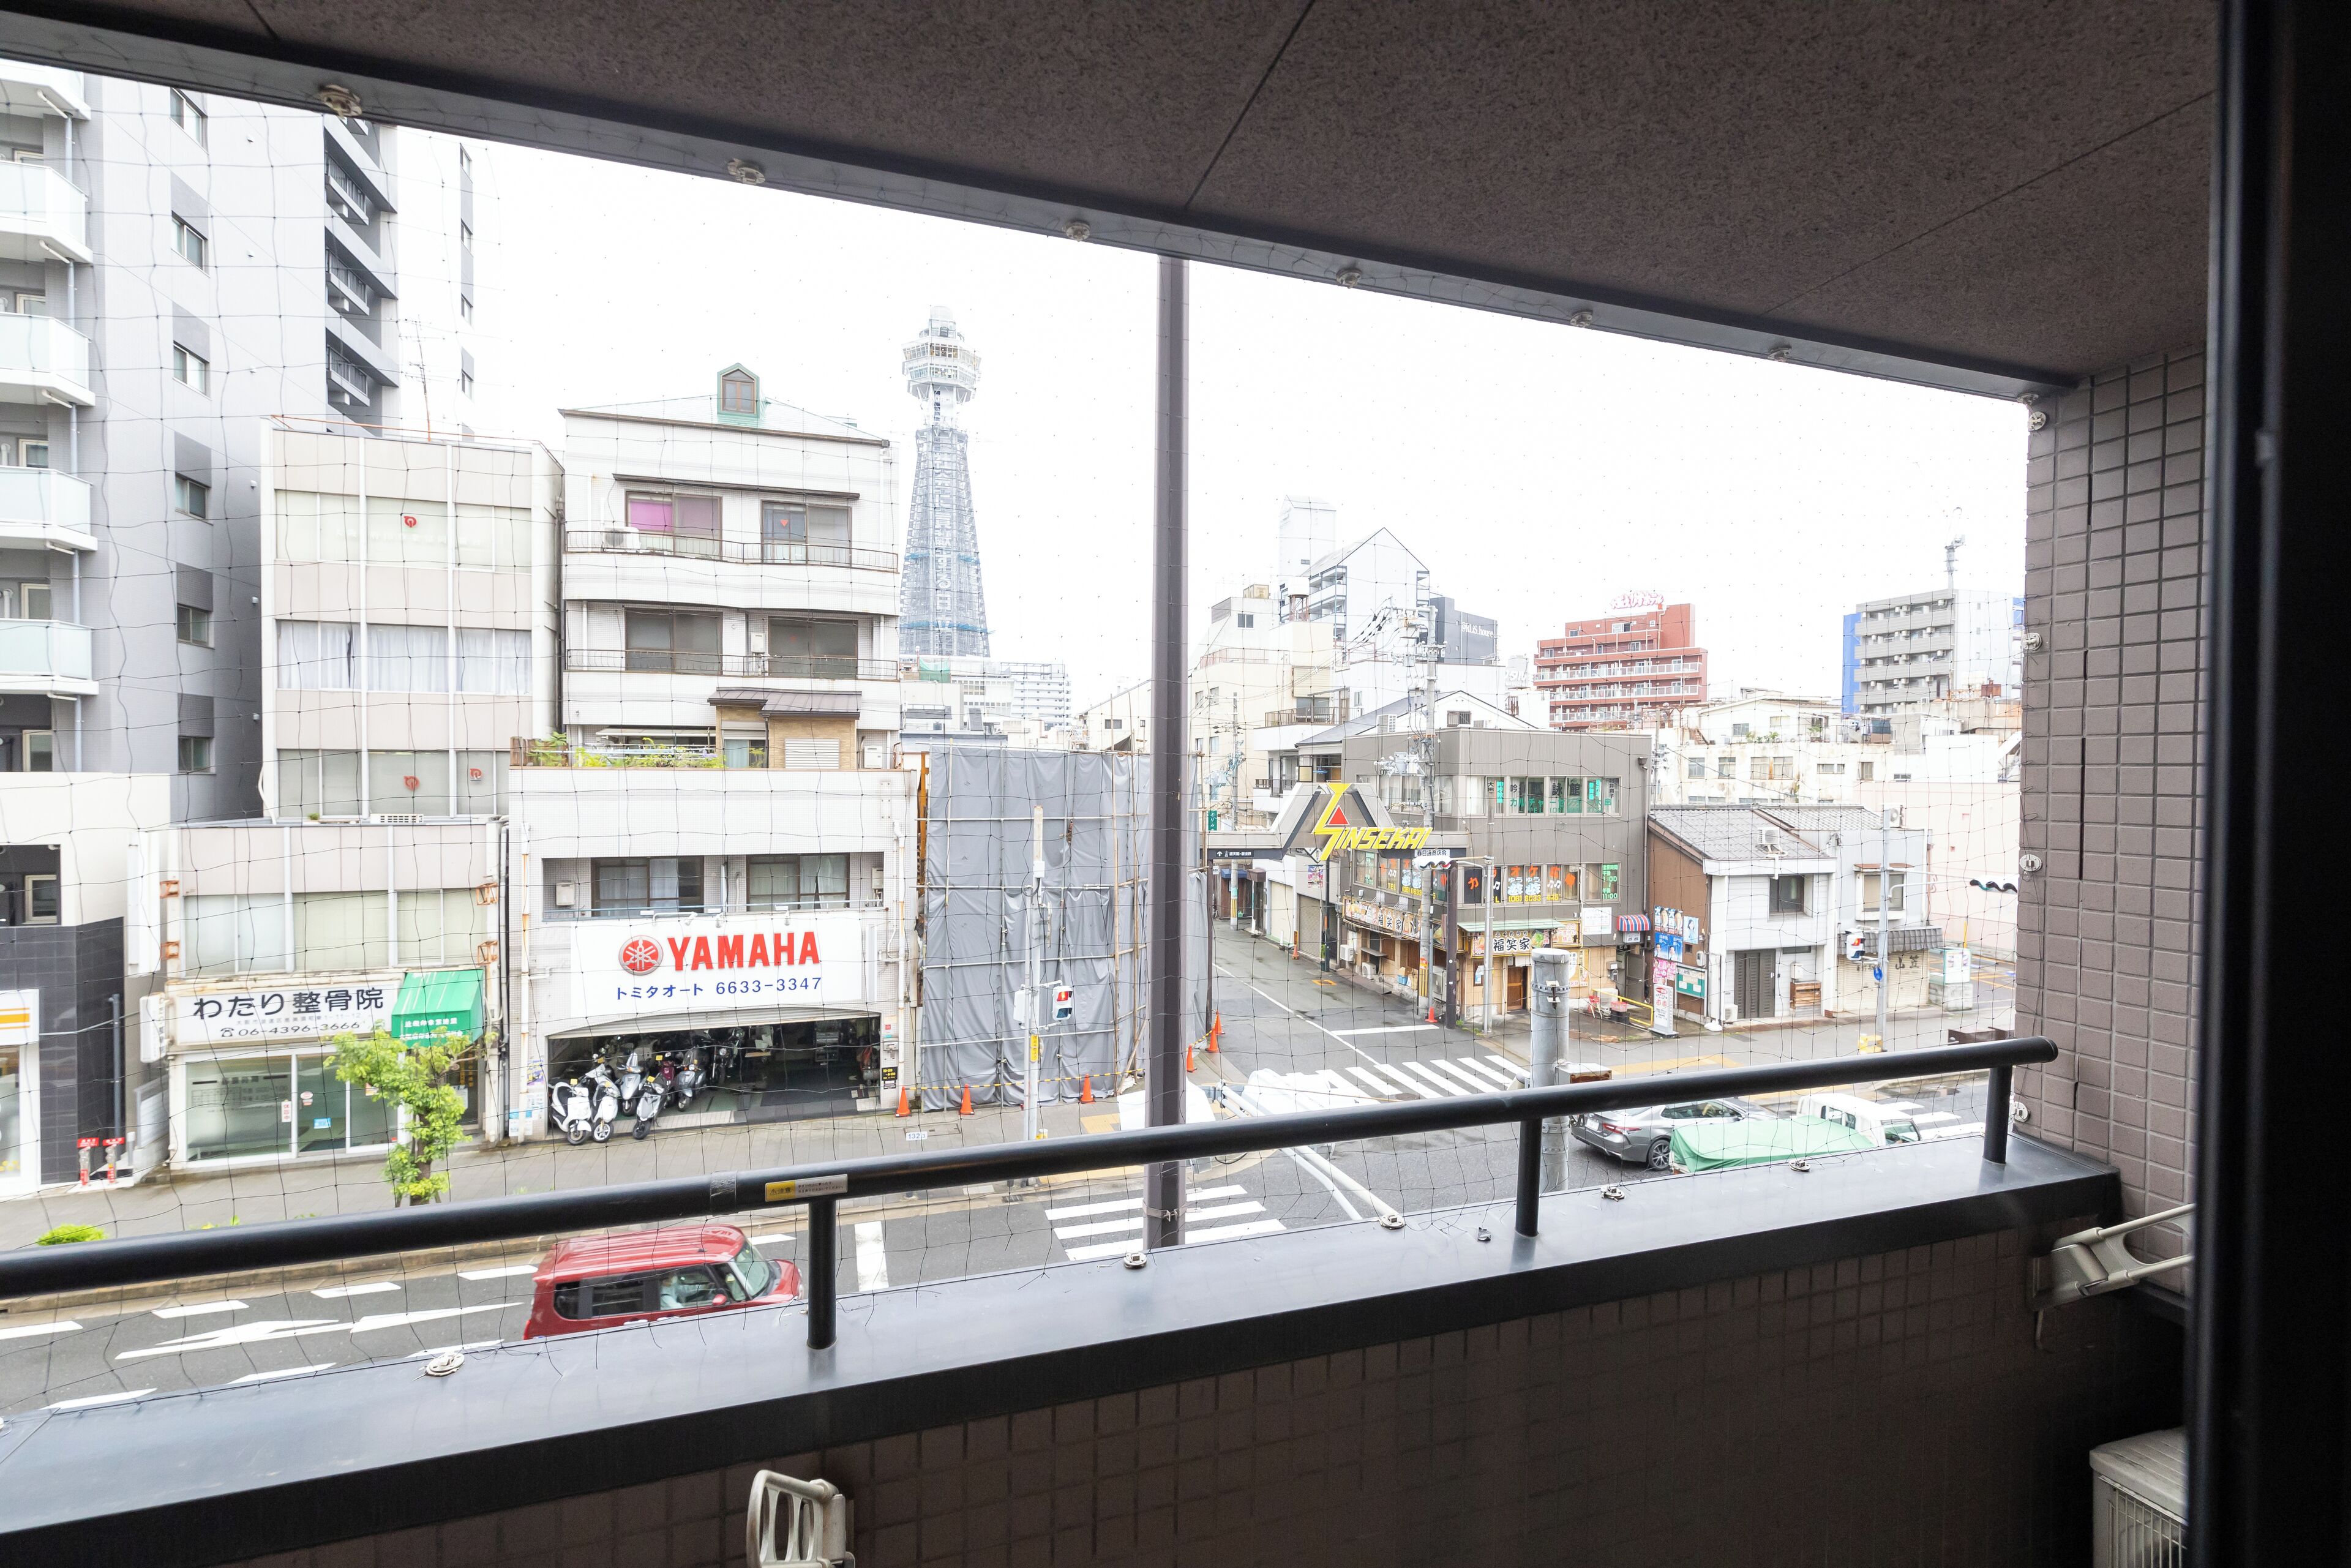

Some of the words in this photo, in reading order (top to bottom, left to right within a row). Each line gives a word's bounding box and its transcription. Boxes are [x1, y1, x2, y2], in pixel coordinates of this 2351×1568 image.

[667, 931, 820, 971] YAMAHA
[1493, 937, 1530, 951] 福笑家
[617, 983, 703, 1000] トミタオート
[716, 977, 822, 994] 6633-3347
[193, 988, 384, 1019] わたり整骨院
[239, 1021, 360, 1037] 06-4396-3666
